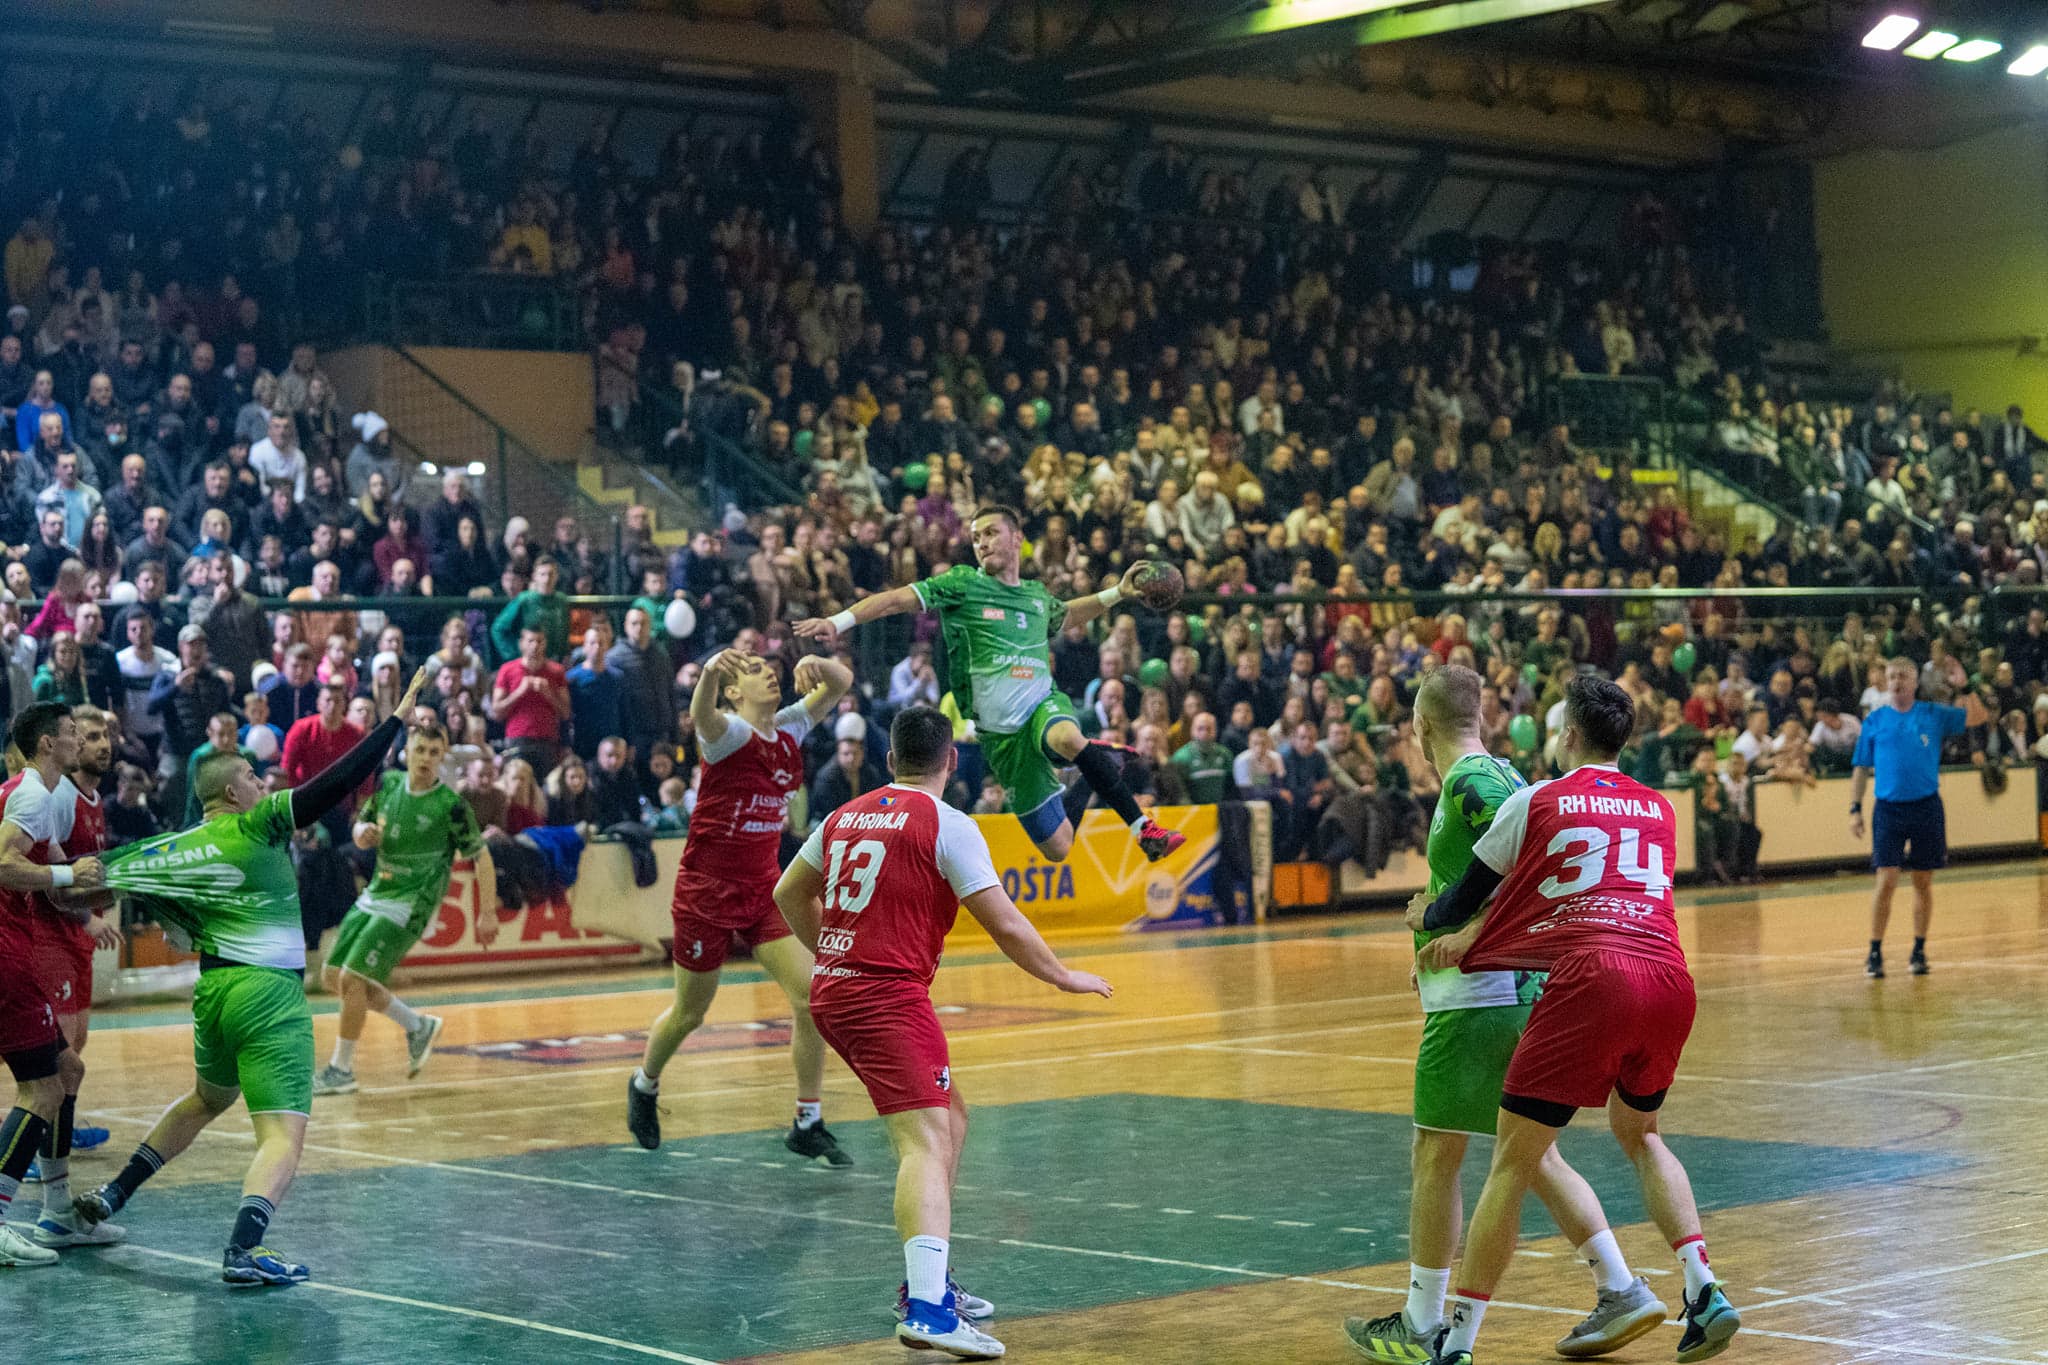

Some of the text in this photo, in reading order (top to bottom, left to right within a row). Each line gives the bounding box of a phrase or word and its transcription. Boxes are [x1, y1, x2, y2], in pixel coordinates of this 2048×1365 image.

[1014, 611, 1028, 629] 3
[1590, 796, 1663, 821] KRIVAJA
[127, 843, 223, 874] BOSNA
[1537, 826, 1673, 900] 34
[825, 839, 887, 913] 13
[1002, 857, 1075, 903] OŠTA
[816, 932, 854, 952] LOKO
